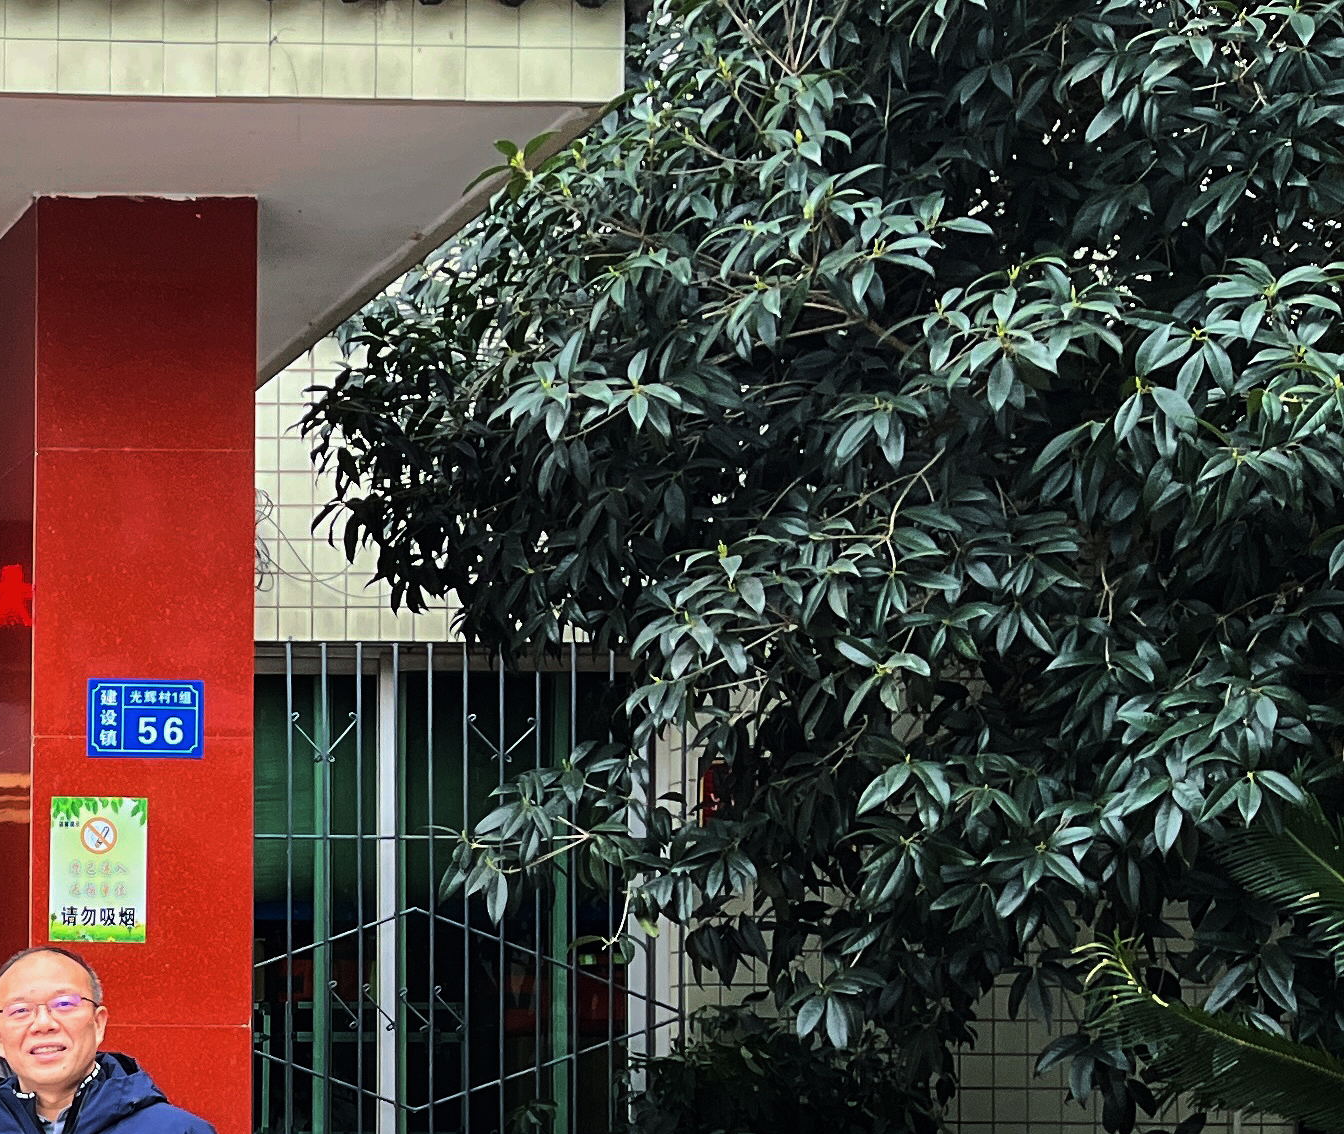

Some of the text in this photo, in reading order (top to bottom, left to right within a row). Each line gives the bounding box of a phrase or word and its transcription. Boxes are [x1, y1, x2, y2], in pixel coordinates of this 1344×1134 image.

[130, 690, 192, 704] 光辉村1组
[100, 689, 118, 746] 建设镇
[137, 717, 184, 745] 56
[61, 906, 136, 927] 请勿吸烟
